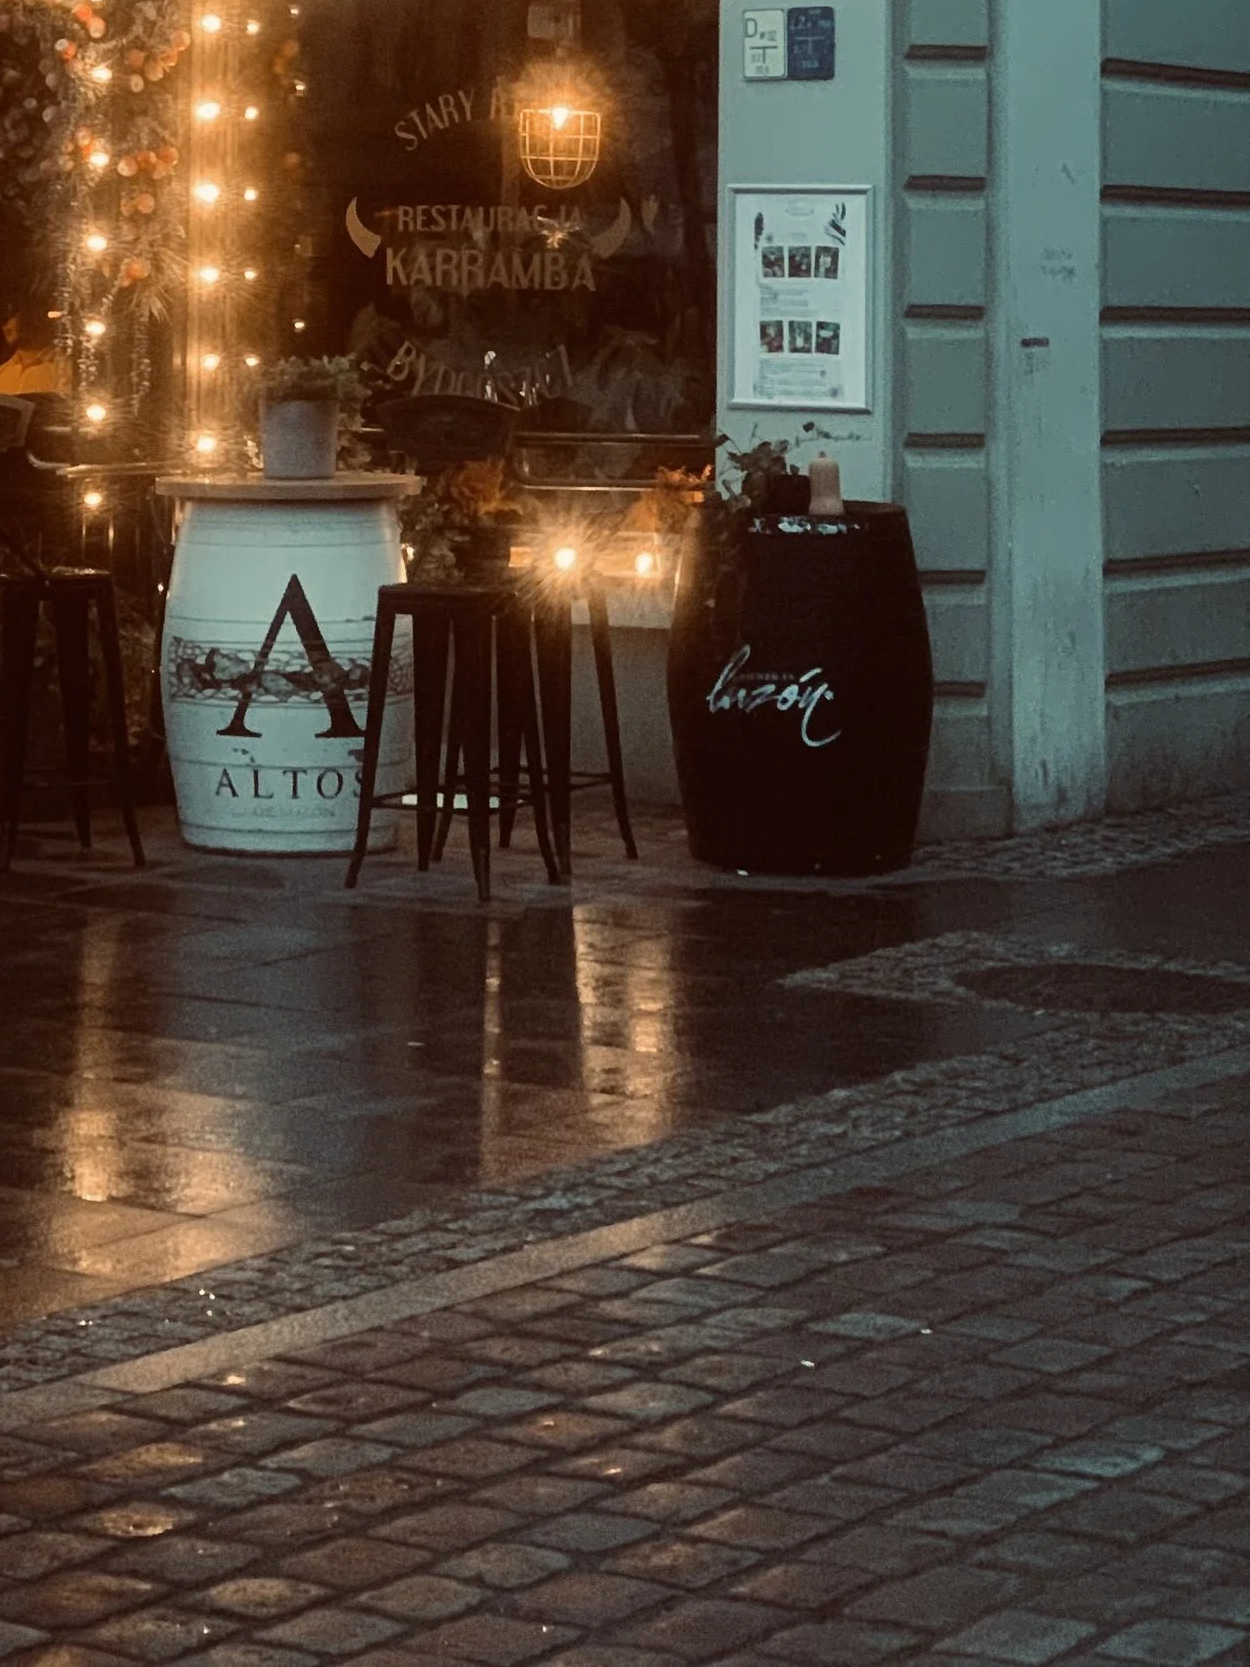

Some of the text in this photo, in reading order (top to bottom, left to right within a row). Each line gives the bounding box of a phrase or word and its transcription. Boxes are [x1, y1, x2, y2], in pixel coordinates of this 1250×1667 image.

[395, 88, 475, 152] STARY
[399, 205, 582, 232] RESTAURACJA
[386, 248, 597, 292] KARRAMBA
[216, 574, 367, 739] A
